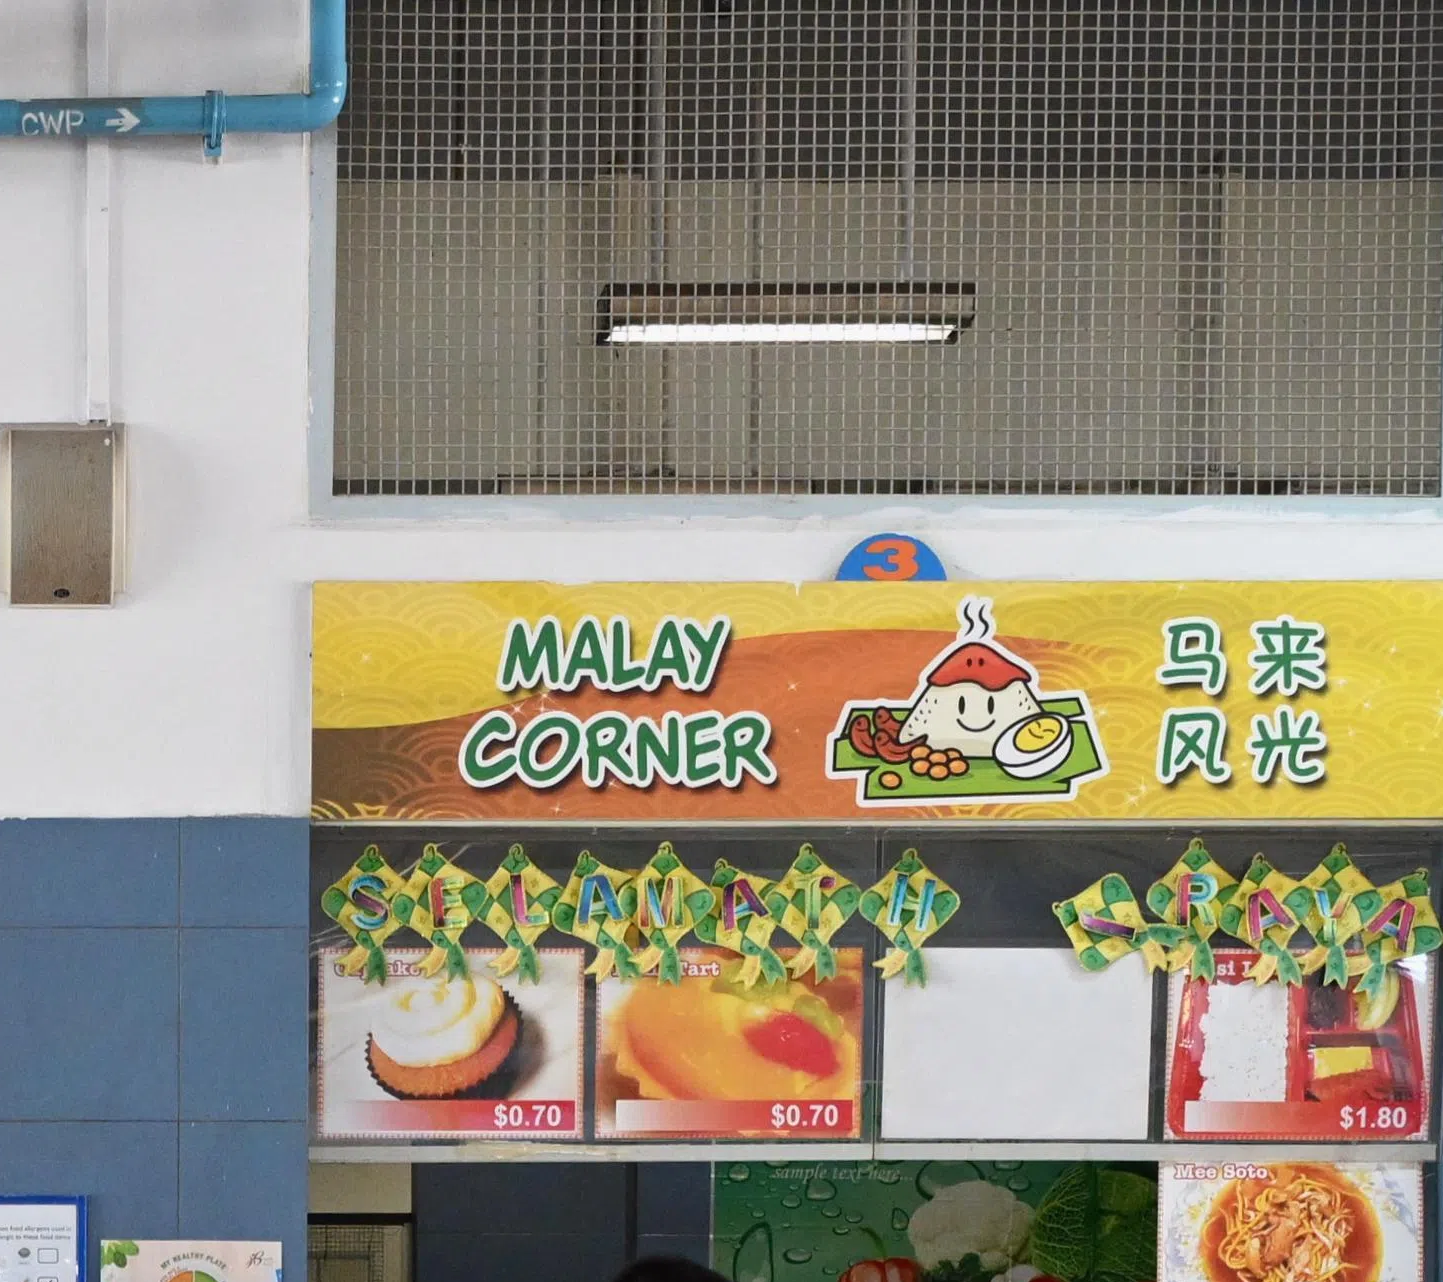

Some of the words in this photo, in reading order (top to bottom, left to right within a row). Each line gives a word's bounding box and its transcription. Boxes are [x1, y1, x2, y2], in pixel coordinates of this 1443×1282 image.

[21, 109, 85, 137] CWP
[863, 539, 918, 580] 3
[497, 613, 732, 692] MALAY
[1158, 614, 1326, 695] 马来
[459, 709, 777, 788] CORNER
[1157, 709, 1326, 783] 风光
[350, 873, 837, 933] SELAMAT
[1179, 873, 1415, 951] RAYA
[677, 959, 721, 977] Tart
[492, 1104, 562, 1130] $0.70
[770, 1104, 839, 1130] $0.70
[1338, 1105, 1408, 1131] $1.80
[772, 1164, 827, 1184] sample
[832, 1166, 861, 1183] text
[1173, 1163, 1216, 1180] Mee
[1222, 1163, 1268, 1181] Soto
[160, 1258, 172, 1270] MY
[173, 1251, 205, 1264] HEALTHY
[206, 1254, 228, 1271] PLATE
